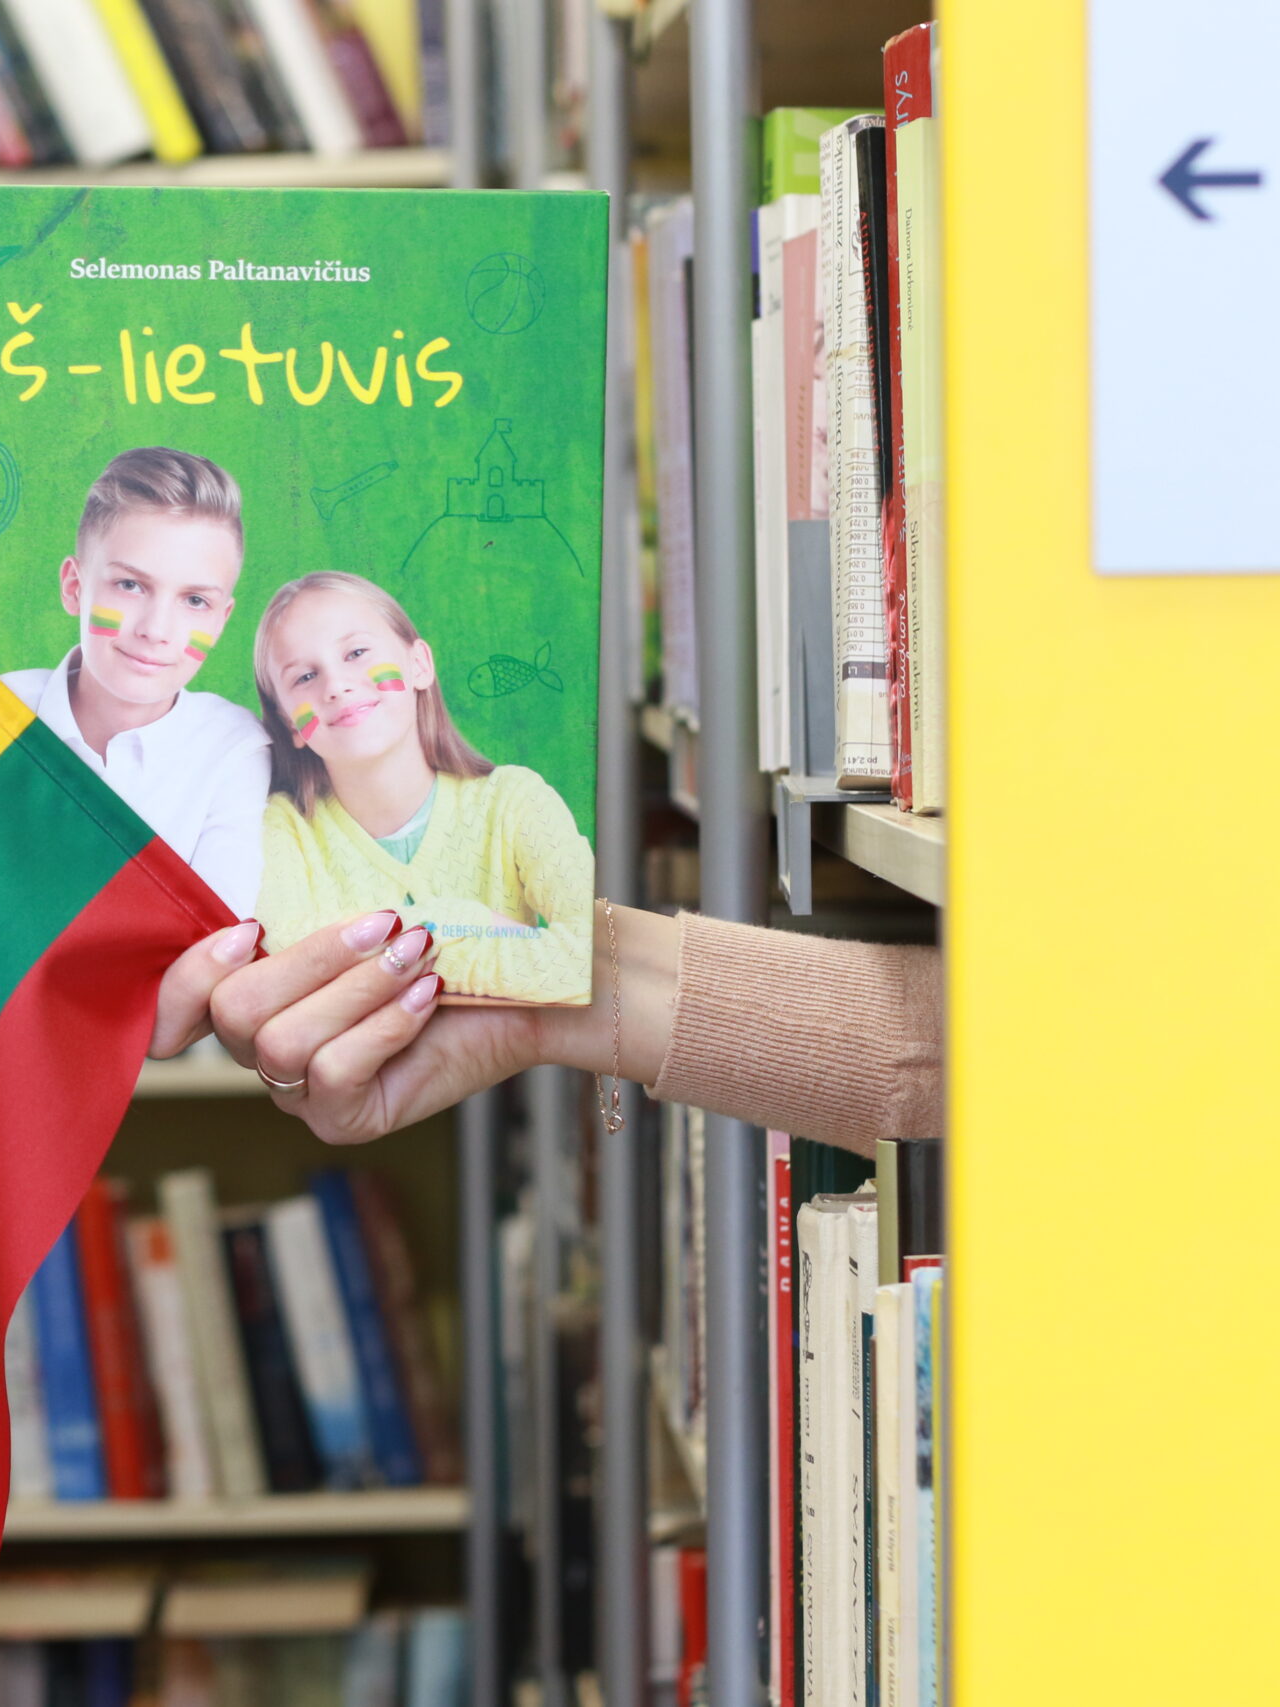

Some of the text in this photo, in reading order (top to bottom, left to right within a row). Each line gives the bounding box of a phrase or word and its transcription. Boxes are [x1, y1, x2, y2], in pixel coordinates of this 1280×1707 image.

[70, 257, 371, 283] Selemonas Paltanavičius
[904, 207, 915, 331] Dainora Urbonienė
[909, 520, 919, 593] Sibiras
[911, 599, 921, 652] vaiko
[912, 657, 922, 731] akimis
[442, 924, 542, 939] DEBESŲ GANYKLOS
